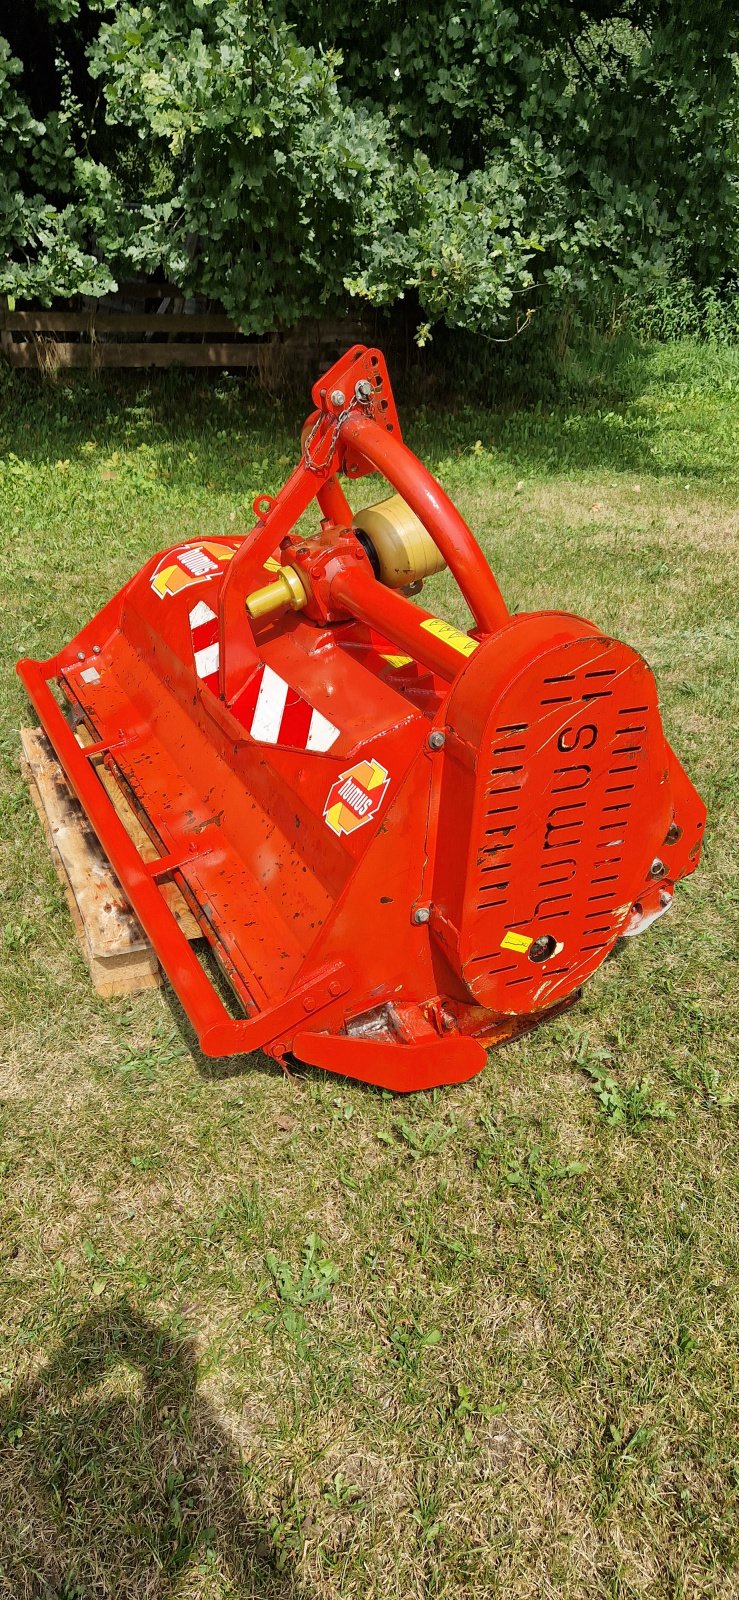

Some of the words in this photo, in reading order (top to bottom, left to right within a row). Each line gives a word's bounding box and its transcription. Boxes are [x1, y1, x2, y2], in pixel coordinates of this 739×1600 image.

[176, 546, 219, 576] humus
[337, 776, 373, 816] humus
[504, 723, 598, 928] humus
